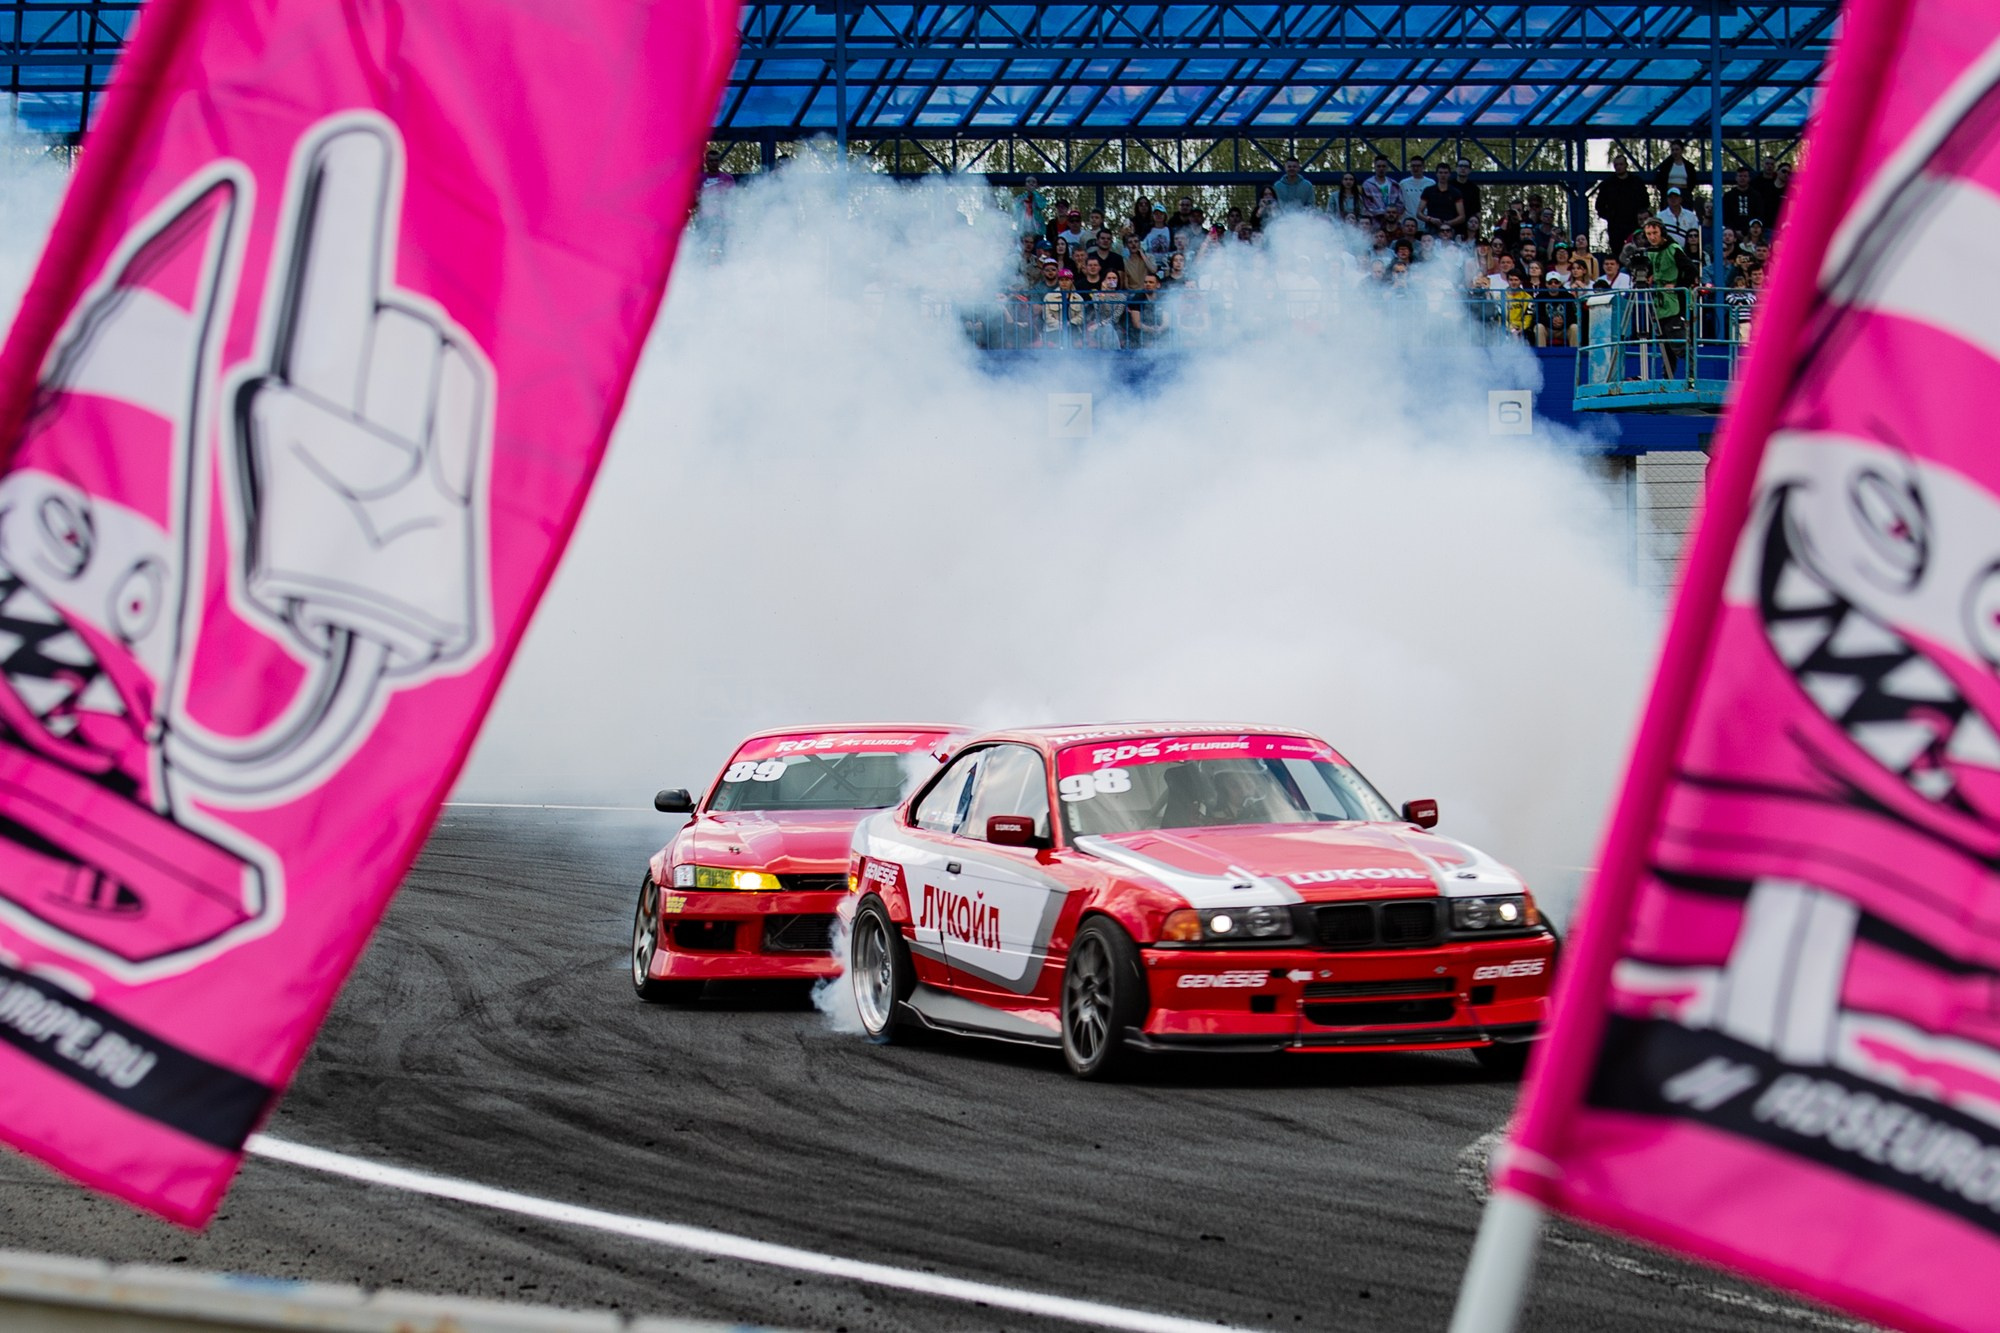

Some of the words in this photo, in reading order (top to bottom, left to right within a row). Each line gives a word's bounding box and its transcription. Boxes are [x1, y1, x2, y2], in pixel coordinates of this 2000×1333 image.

[1058, 403, 1082, 427] 7
[1499, 400, 1522, 424] 6
[775, 738, 837, 752] RDS
[1092, 743, 1161, 764] RDS
[1191, 741, 1249, 751] EUROPE
[723, 761, 788, 783] 89
[1059, 767, 1132, 802] 98
[864, 862, 899, 886] GENESIS
[1287, 867, 1428, 885] LUKOIL
[920, 884, 1000, 952] ЛУКОЙЛ
[1176, 973, 1269, 988] GENESIS
[1472, 962, 1545, 980] GENESIS
